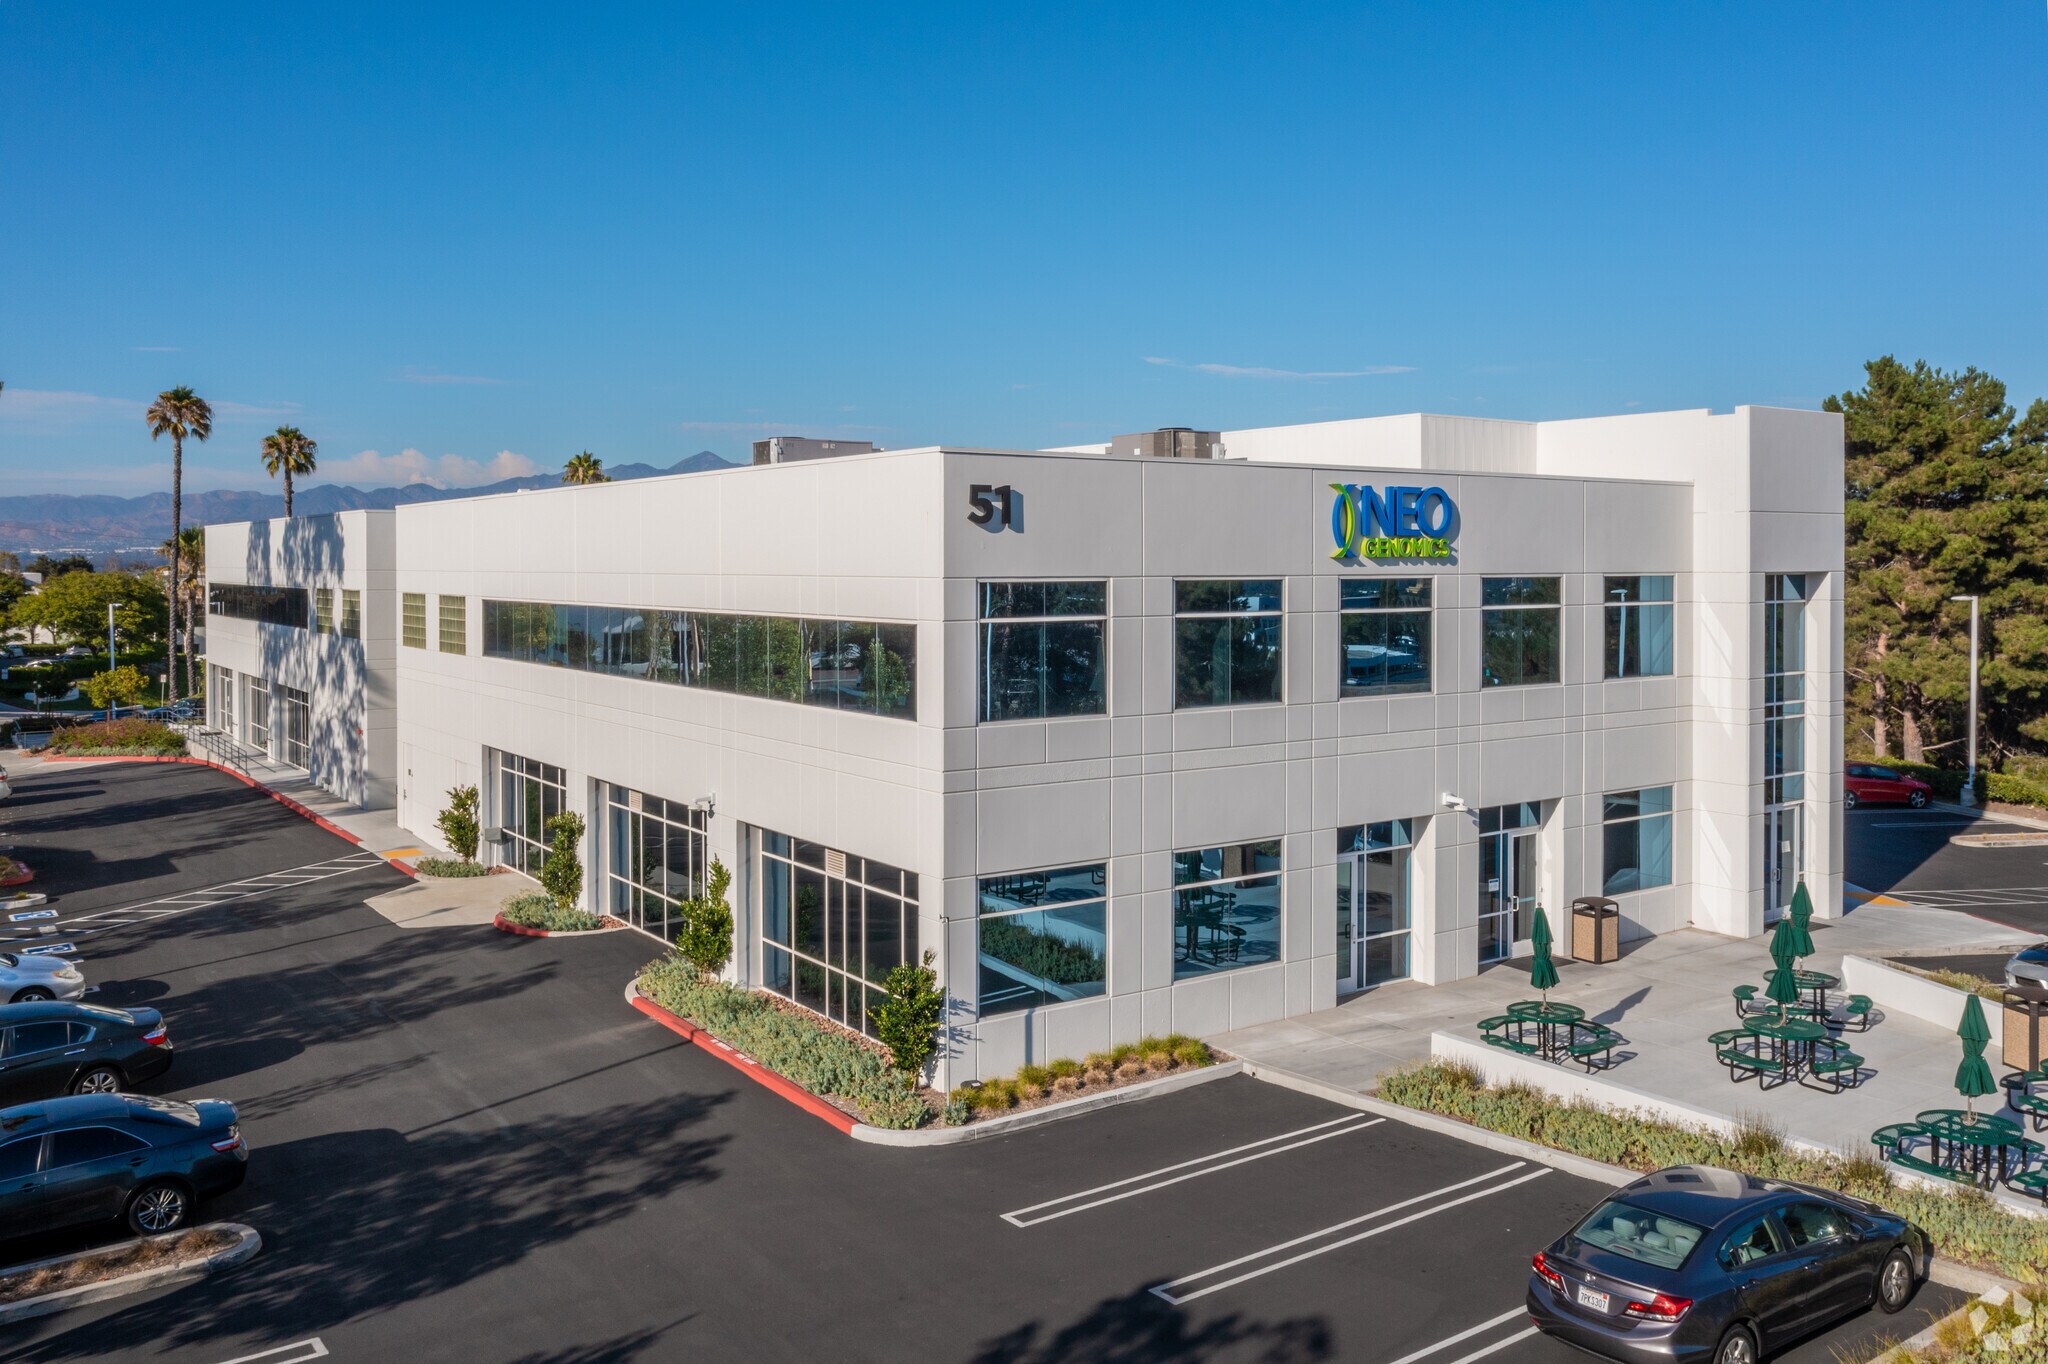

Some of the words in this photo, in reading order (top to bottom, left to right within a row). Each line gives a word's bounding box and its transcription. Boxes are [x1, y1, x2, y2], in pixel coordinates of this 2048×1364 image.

[967, 484, 1011, 525] 51
[1361, 485, 1453, 537] NEO
[1360, 537, 1450, 558] GENOMICS
